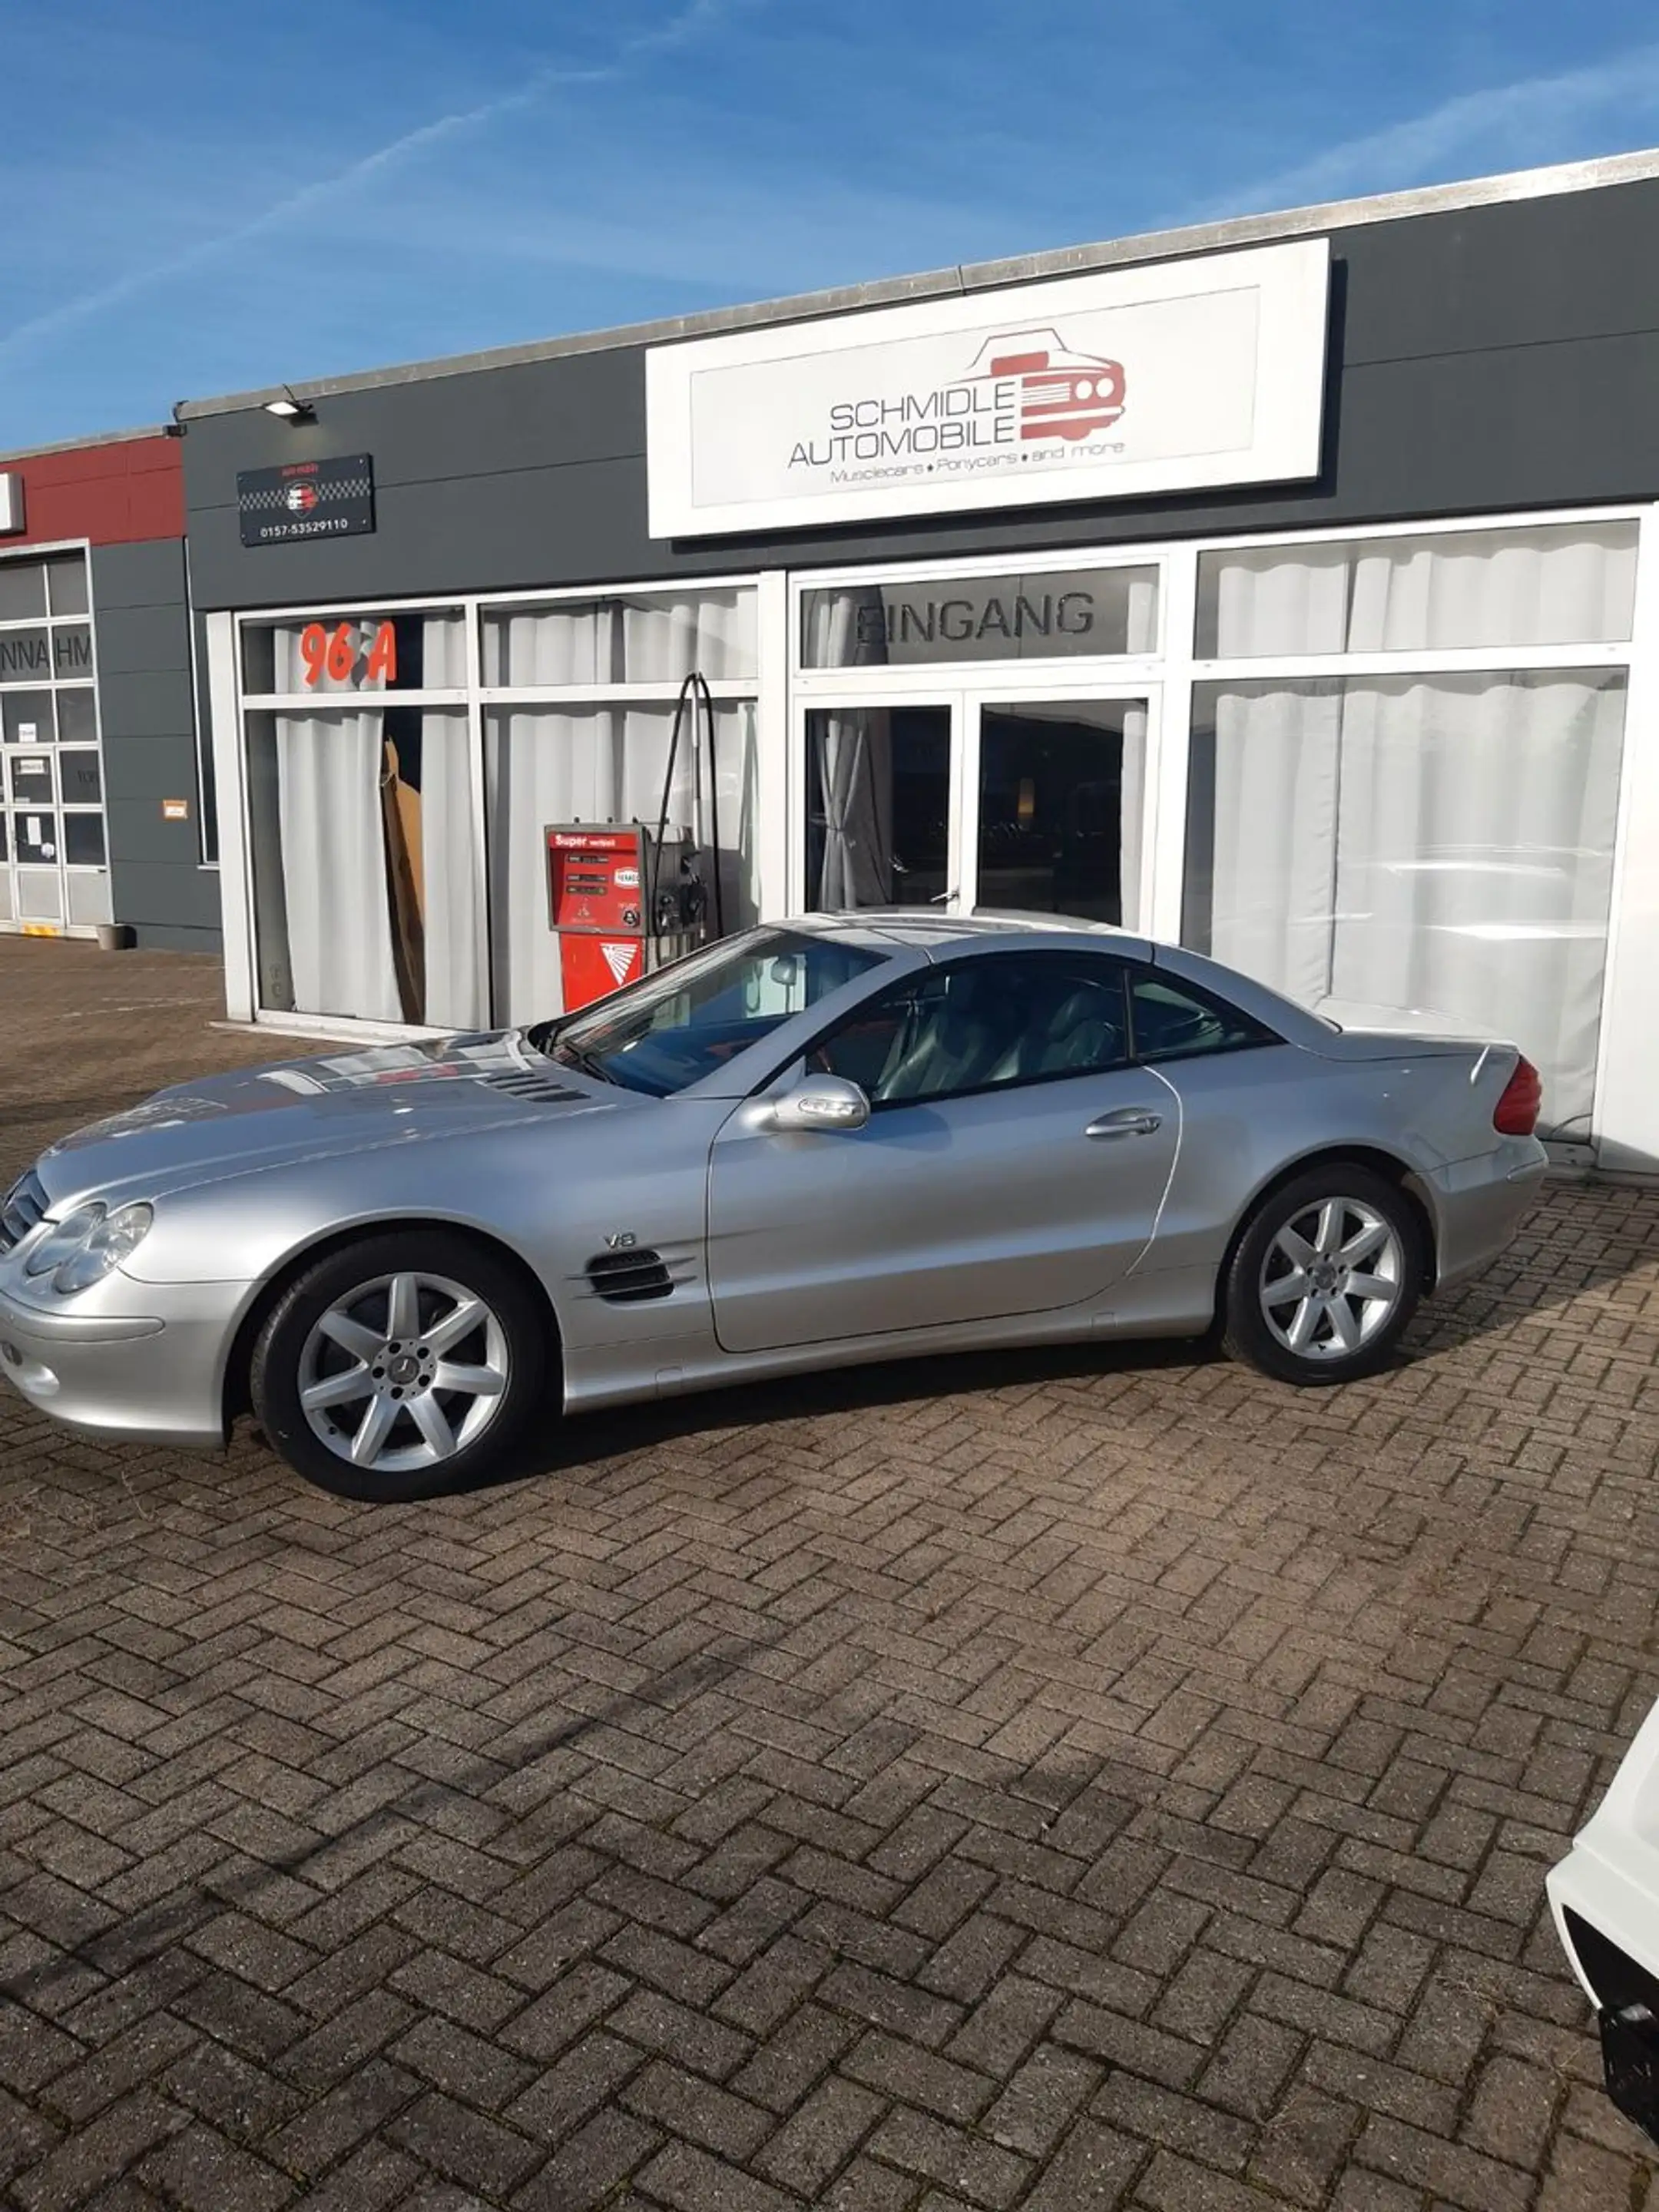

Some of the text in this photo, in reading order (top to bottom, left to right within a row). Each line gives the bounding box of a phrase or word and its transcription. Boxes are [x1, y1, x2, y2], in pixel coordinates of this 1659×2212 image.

[830, 381, 1015, 431] SCHMIDLE
[788, 415, 1015, 469] AUTOMOBILE
[830, 442, 1126, 483] Musclecars Ponycars and more
[260, 518, 348, 537] 0157-53529110
[856, 591, 1094, 644] EINGANG
[300, 620, 397, 686] 96 A
[555, 834, 587, 847] Super
[603, 1233, 636, 1249] V8
